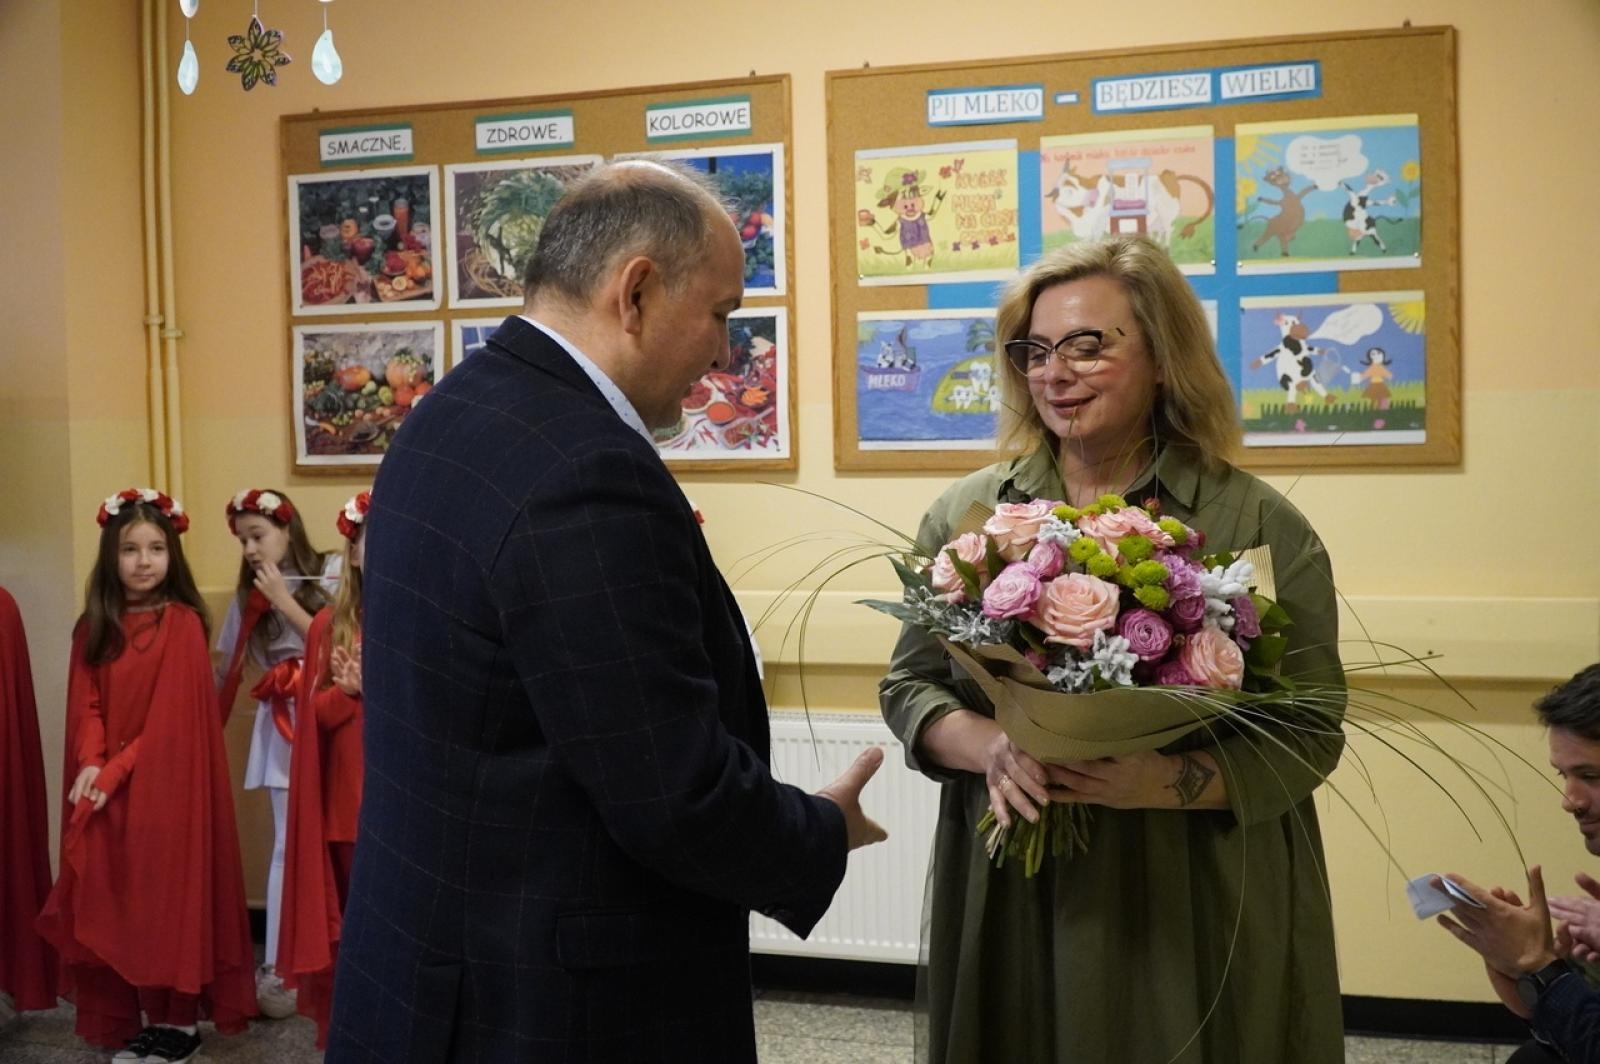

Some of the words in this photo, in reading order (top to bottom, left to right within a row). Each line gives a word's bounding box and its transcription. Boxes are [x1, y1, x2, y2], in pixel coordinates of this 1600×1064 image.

[931, 96, 957, 119] PIJ
[964, 91, 1040, 115] MLEKO
[1100, 76, 1209, 108] BĘDZIESZ
[1225, 68, 1312, 95] WIELKI
[327, 135, 407, 156] SMACZNE,
[486, 123, 563, 144] ZDROWE,
[650, 108, 747, 132] KOLOROWE
